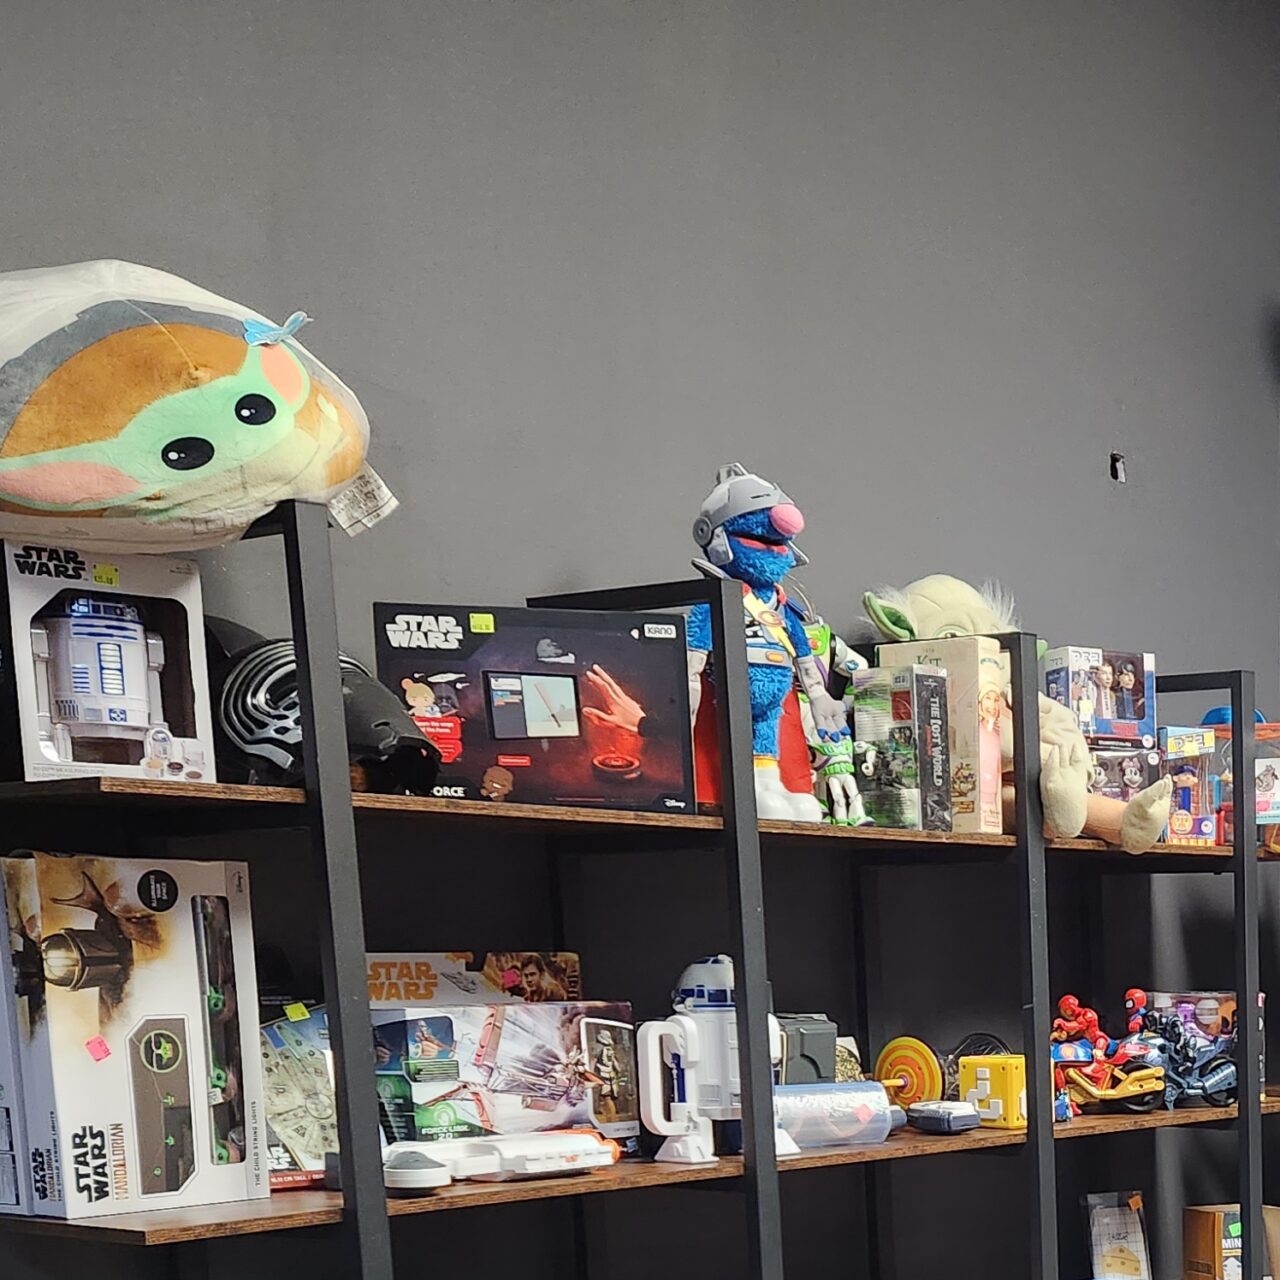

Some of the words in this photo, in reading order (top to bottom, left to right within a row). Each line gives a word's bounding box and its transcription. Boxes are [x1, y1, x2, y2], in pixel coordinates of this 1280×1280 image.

[14, 546, 85, 565] STAR
[15, 559, 86, 580] WARS
[386, 614, 463, 633] STAR
[386, 631, 463, 649] WARS
[930, 695, 940, 719] THE
[932, 748, 944, 787] WORLD
[430, 786, 466, 797] ORCE
[369, 961, 437, 981] STAR
[368, 981, 438, 1001] WARS
[72, 1126, 92, 1203] STAR
[89, 1126, 109, 1202] WARS
[109, 1123, 128, 1200] MANDALORIAN
